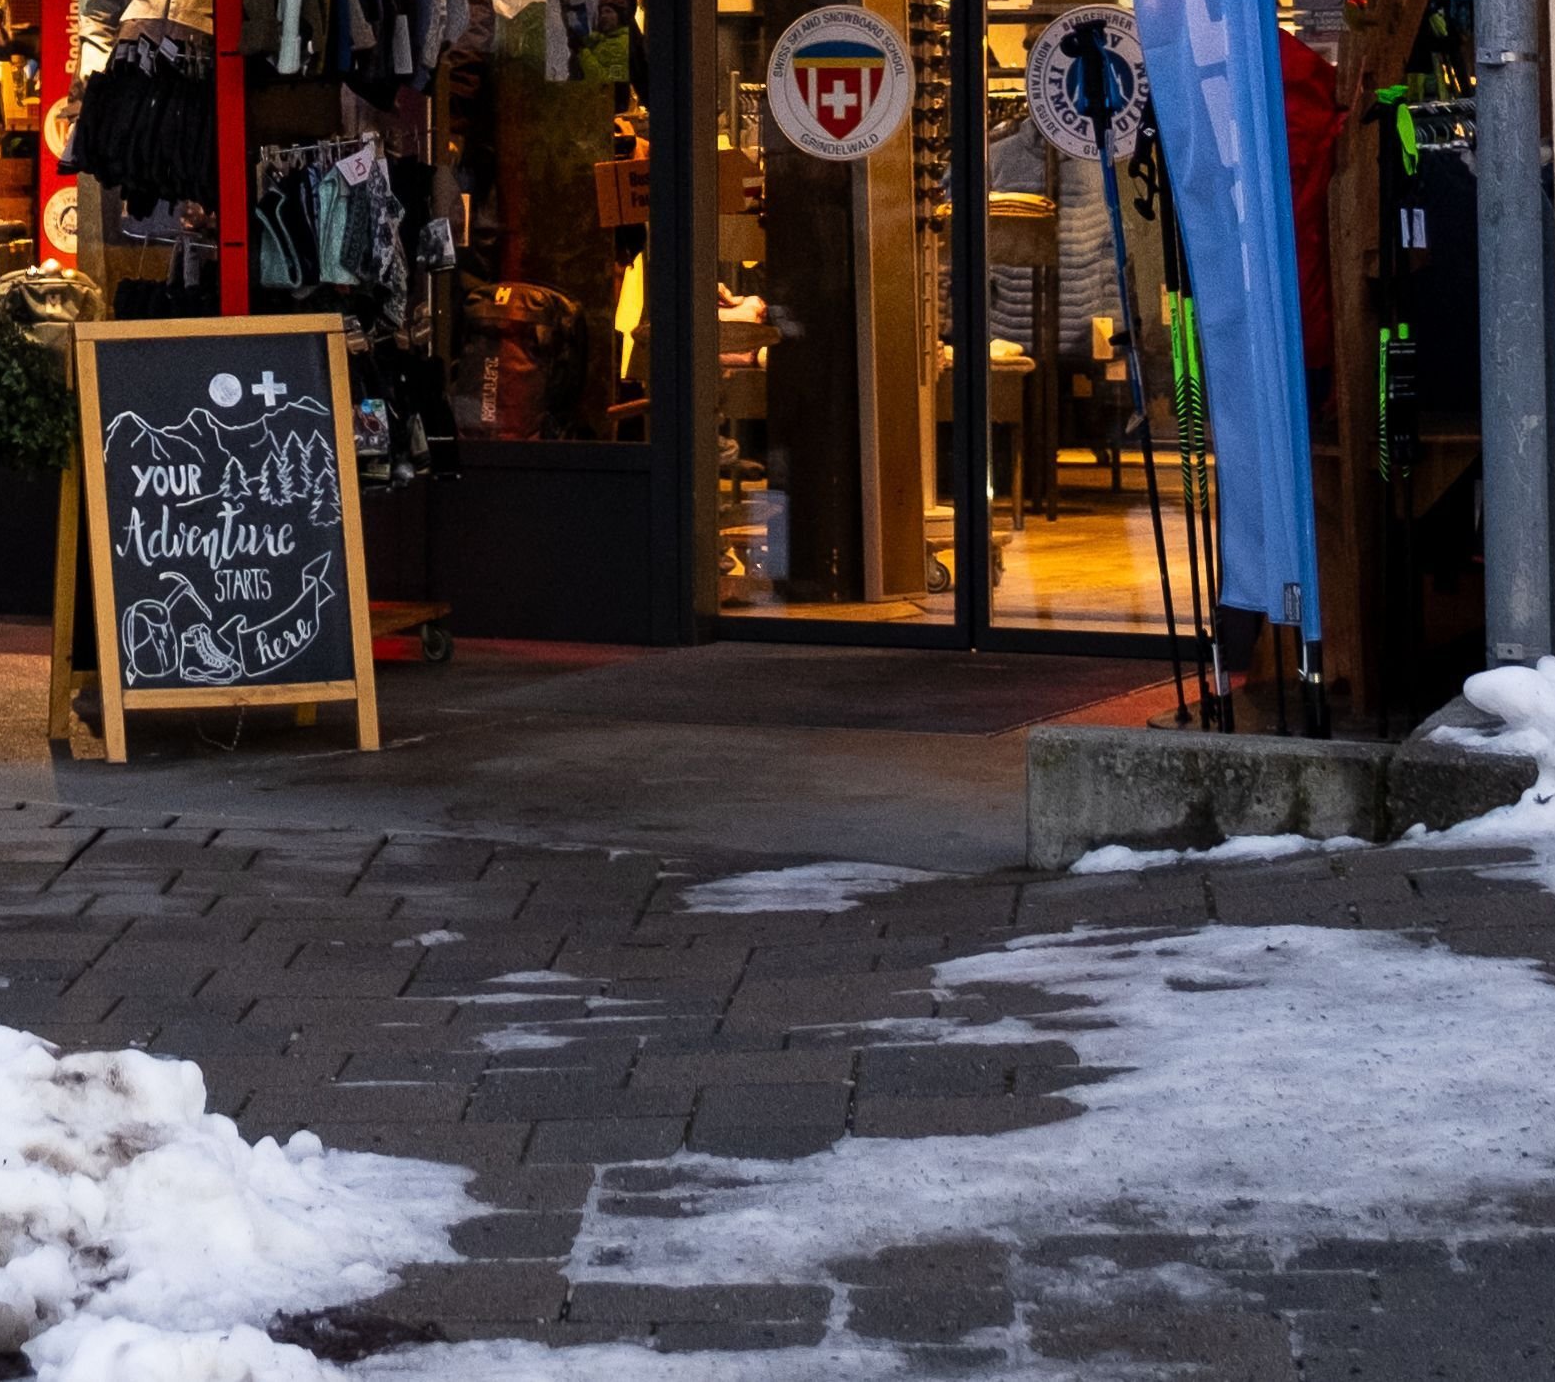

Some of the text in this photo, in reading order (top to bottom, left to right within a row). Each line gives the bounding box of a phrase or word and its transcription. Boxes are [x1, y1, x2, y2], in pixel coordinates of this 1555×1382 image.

[773, 12, 906, 78] SWISS SKI AND SNOWBOARD SCHOOL
[1031, 41, 1052, 100] MOUNTAIN
[1048, 66, 1090, 136] IFMGA
[801, 134, 879, 155] GRINDELWALD
[131, 463, 202, 497] YOUR
[116, 502, 296, 569] Adventure
[215, 568, 272, 603] STARTS
[256, 617, 317, 665] here
